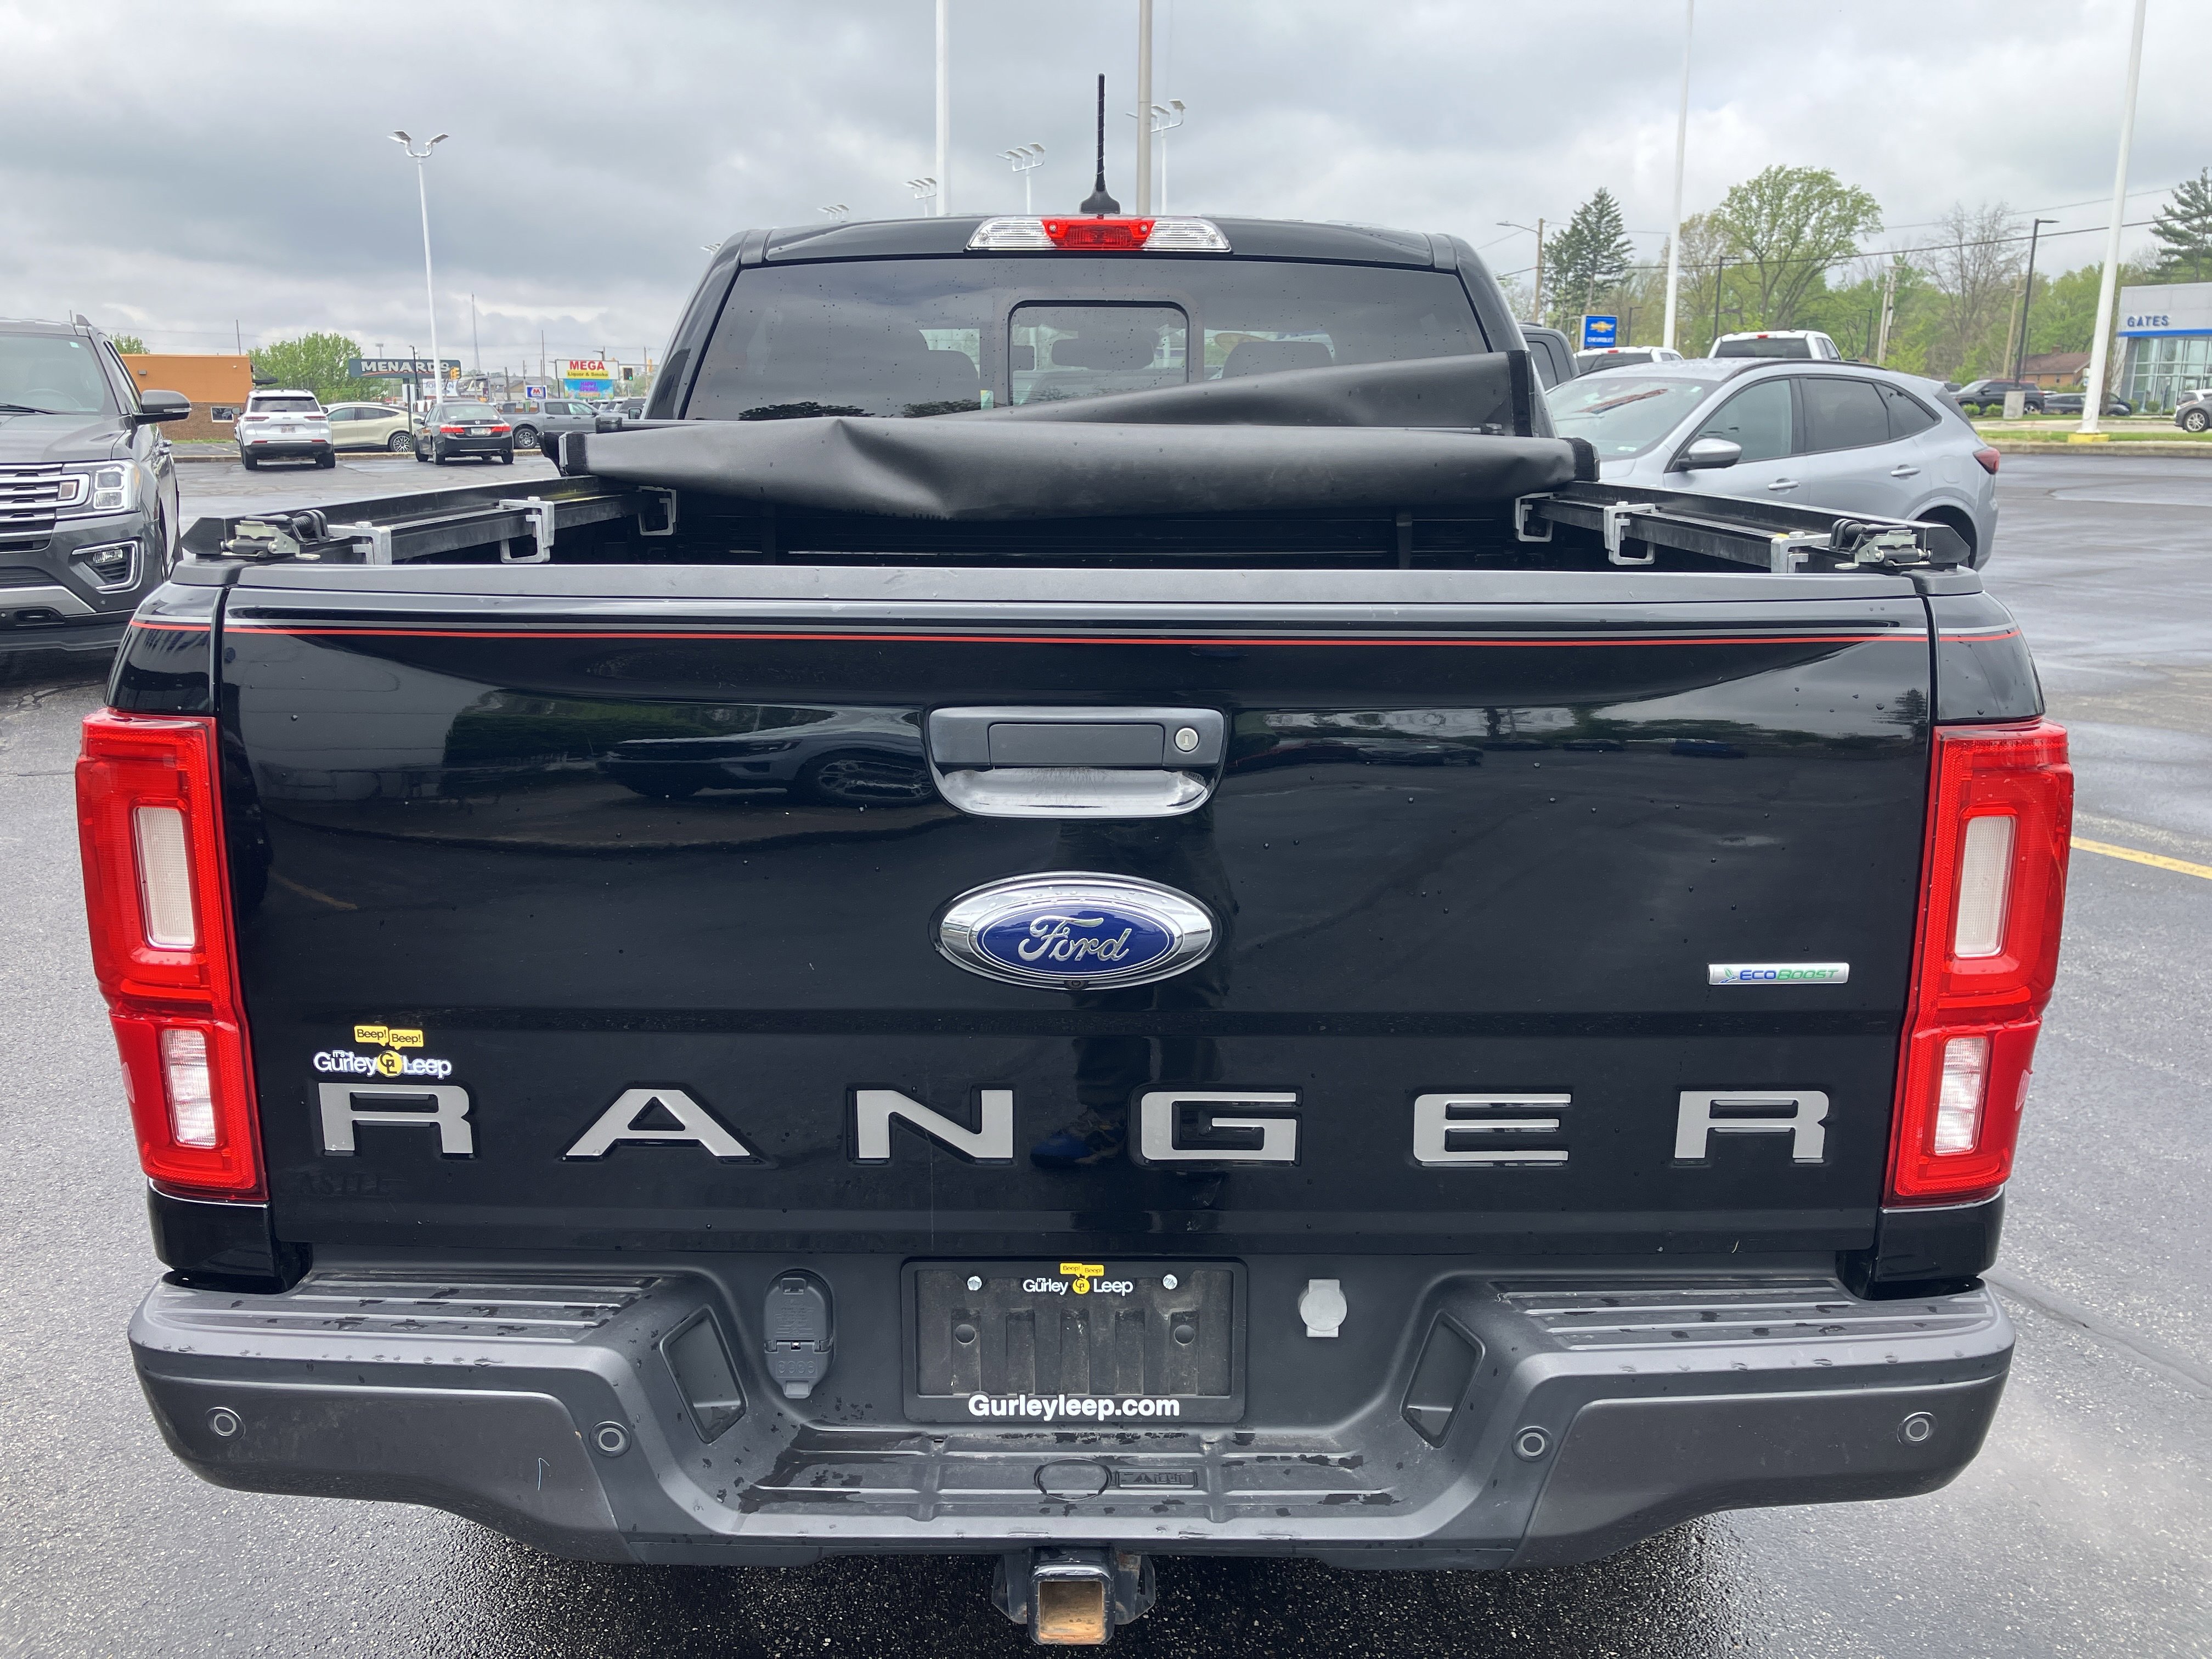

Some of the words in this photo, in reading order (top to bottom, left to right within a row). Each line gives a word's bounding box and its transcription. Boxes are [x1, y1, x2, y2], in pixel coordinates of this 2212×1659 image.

[2128, 315, 2169, 327] GATES
[361, 361, 450, 372] MENARDS
[569, 360, 605, 370] MEGA
[1018, 916, 1133, 961] Ford
[357, 1029, 387, 1041] Beep!
[392, 1034, 421, 1044] Beep!
[314, 1052, 377, 1076] Gurley
[403, 1056, 452, 1079] Leep
[318, 1083, 1829, 1162] RANGER
[1023, 1278, 1069, 1295] Gurley
[1093, 1278, 1133, 1296] Leep
[968, 1395, 1180, 1421] Gurleyleep.com
